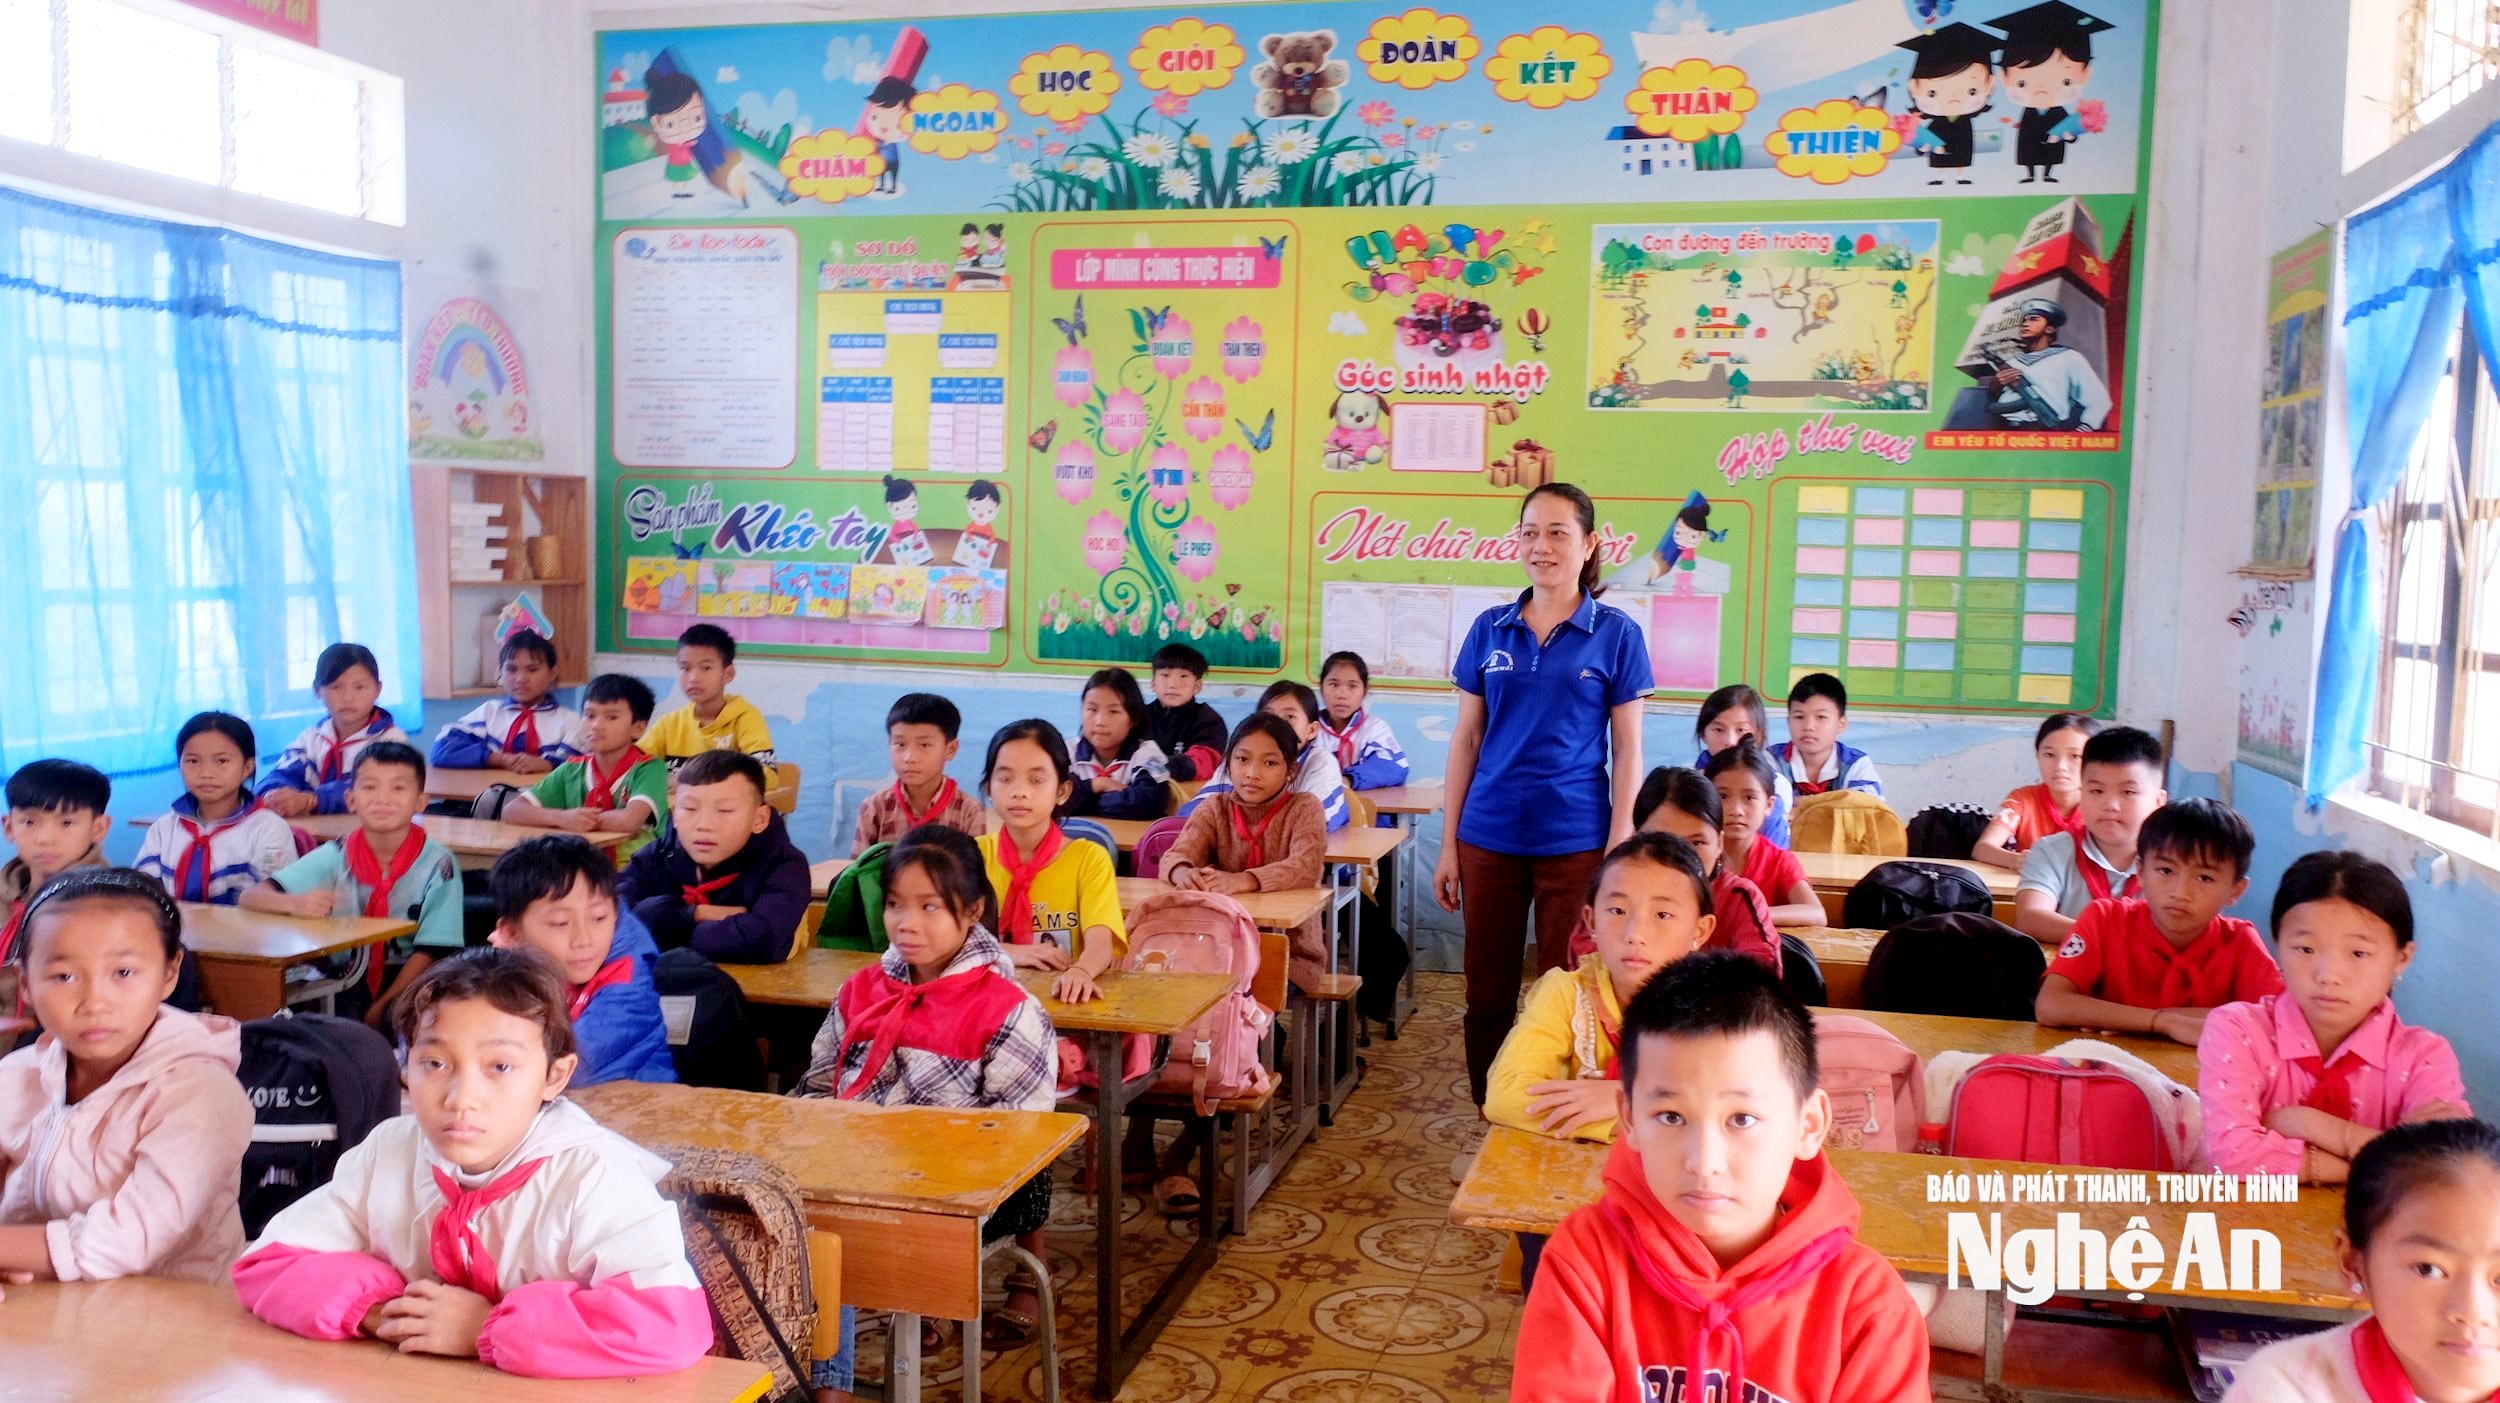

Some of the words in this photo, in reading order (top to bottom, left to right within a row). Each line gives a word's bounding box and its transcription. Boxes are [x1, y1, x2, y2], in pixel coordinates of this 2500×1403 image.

[1380, 34, 1458, 64] ĐOÀN
[1519, 48, 1576, 86] KẾT
[1038, 69, 1092, 99] HỌC
[1651, 87, 1732, 117] THÂN
[912, 111, 996, 135] NGOAN
[1785, 126, 1881, 161] THIỆN
[1643, 234, 1673, 251] Con
[1679, 233, 1730, 254] đường
[1737, 227, 1768, 251] đến
[1773, 230, 1830, 254] trường
[1075, 252, 1102, 282] LỚP
[1338, 361, 1394, 388] Góc
[1403, 361, 1463, 388] sinh
[1475, 361, 1547, 399] nhật
[1718, 430, 1788, 485] Hộp
[1797, 412, 1857, 453] thư
[1860, 429, 1916, 463] vui
[1933, 436, 1956, 447] EM
[2081, 436, 2116, 448] NAM
[715, 505, 820, 554] Khéo
[827, 510, 888, 562] tay
[1317, 506, 1403, 563] Nét
[1408, 518, 1473, 562] chữ
[1473, 524, 1522, 563] nế
